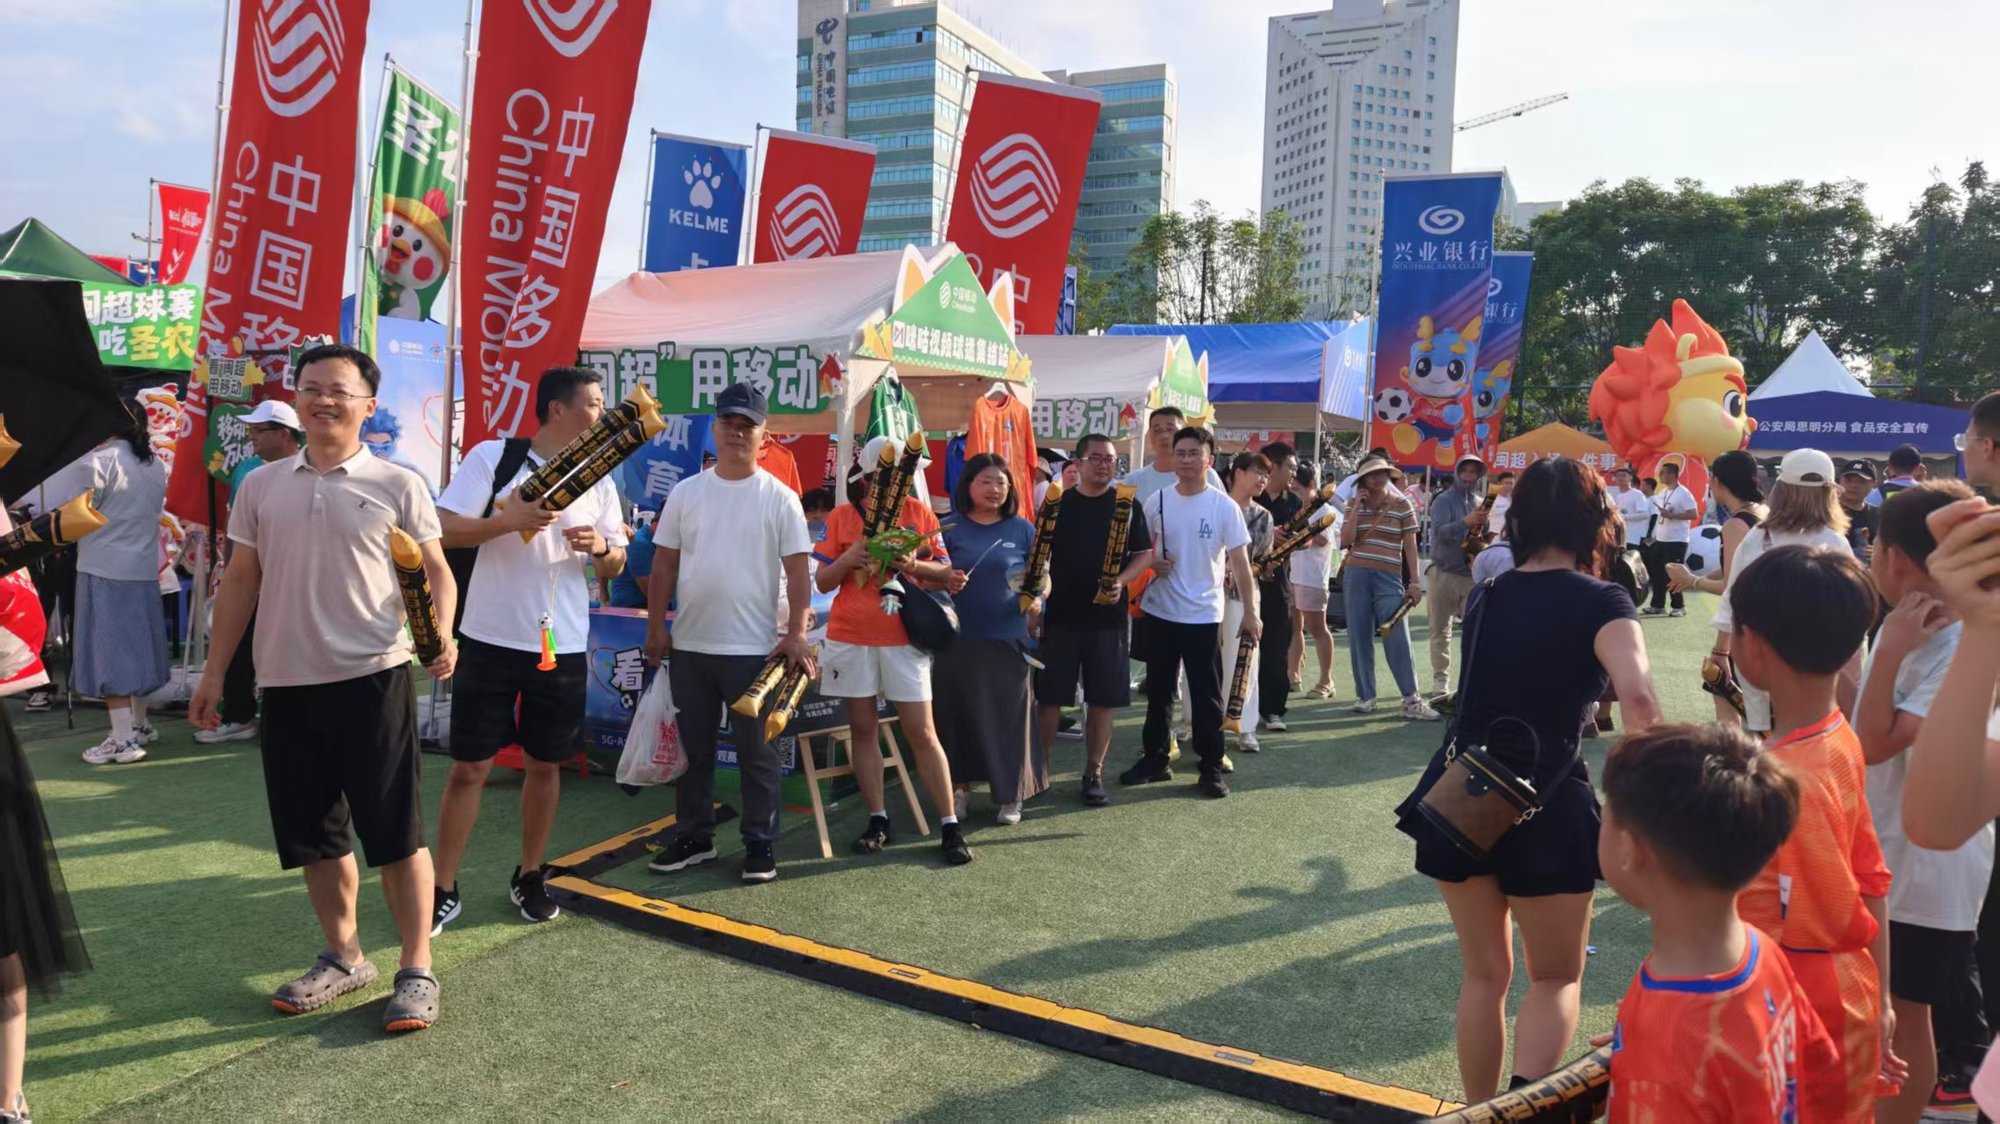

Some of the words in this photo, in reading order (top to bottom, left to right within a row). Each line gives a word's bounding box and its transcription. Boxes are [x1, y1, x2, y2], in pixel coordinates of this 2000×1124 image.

[489, 88, 551, 241] China
[183, 140, 261, 275] China
[668, 208, 729, 234] KELME
[1393, 241, 1489, 261] 兴业银行
[98, 322, 195, 362] 吃圣农
[692, 348, 818, 409] 用移动
[1033, 399, 1119, 439] 用移动
[1759, 421, 1847, 433] 公安局思明分局
[1850, 422, 1929, 434] 食品安全宣传
